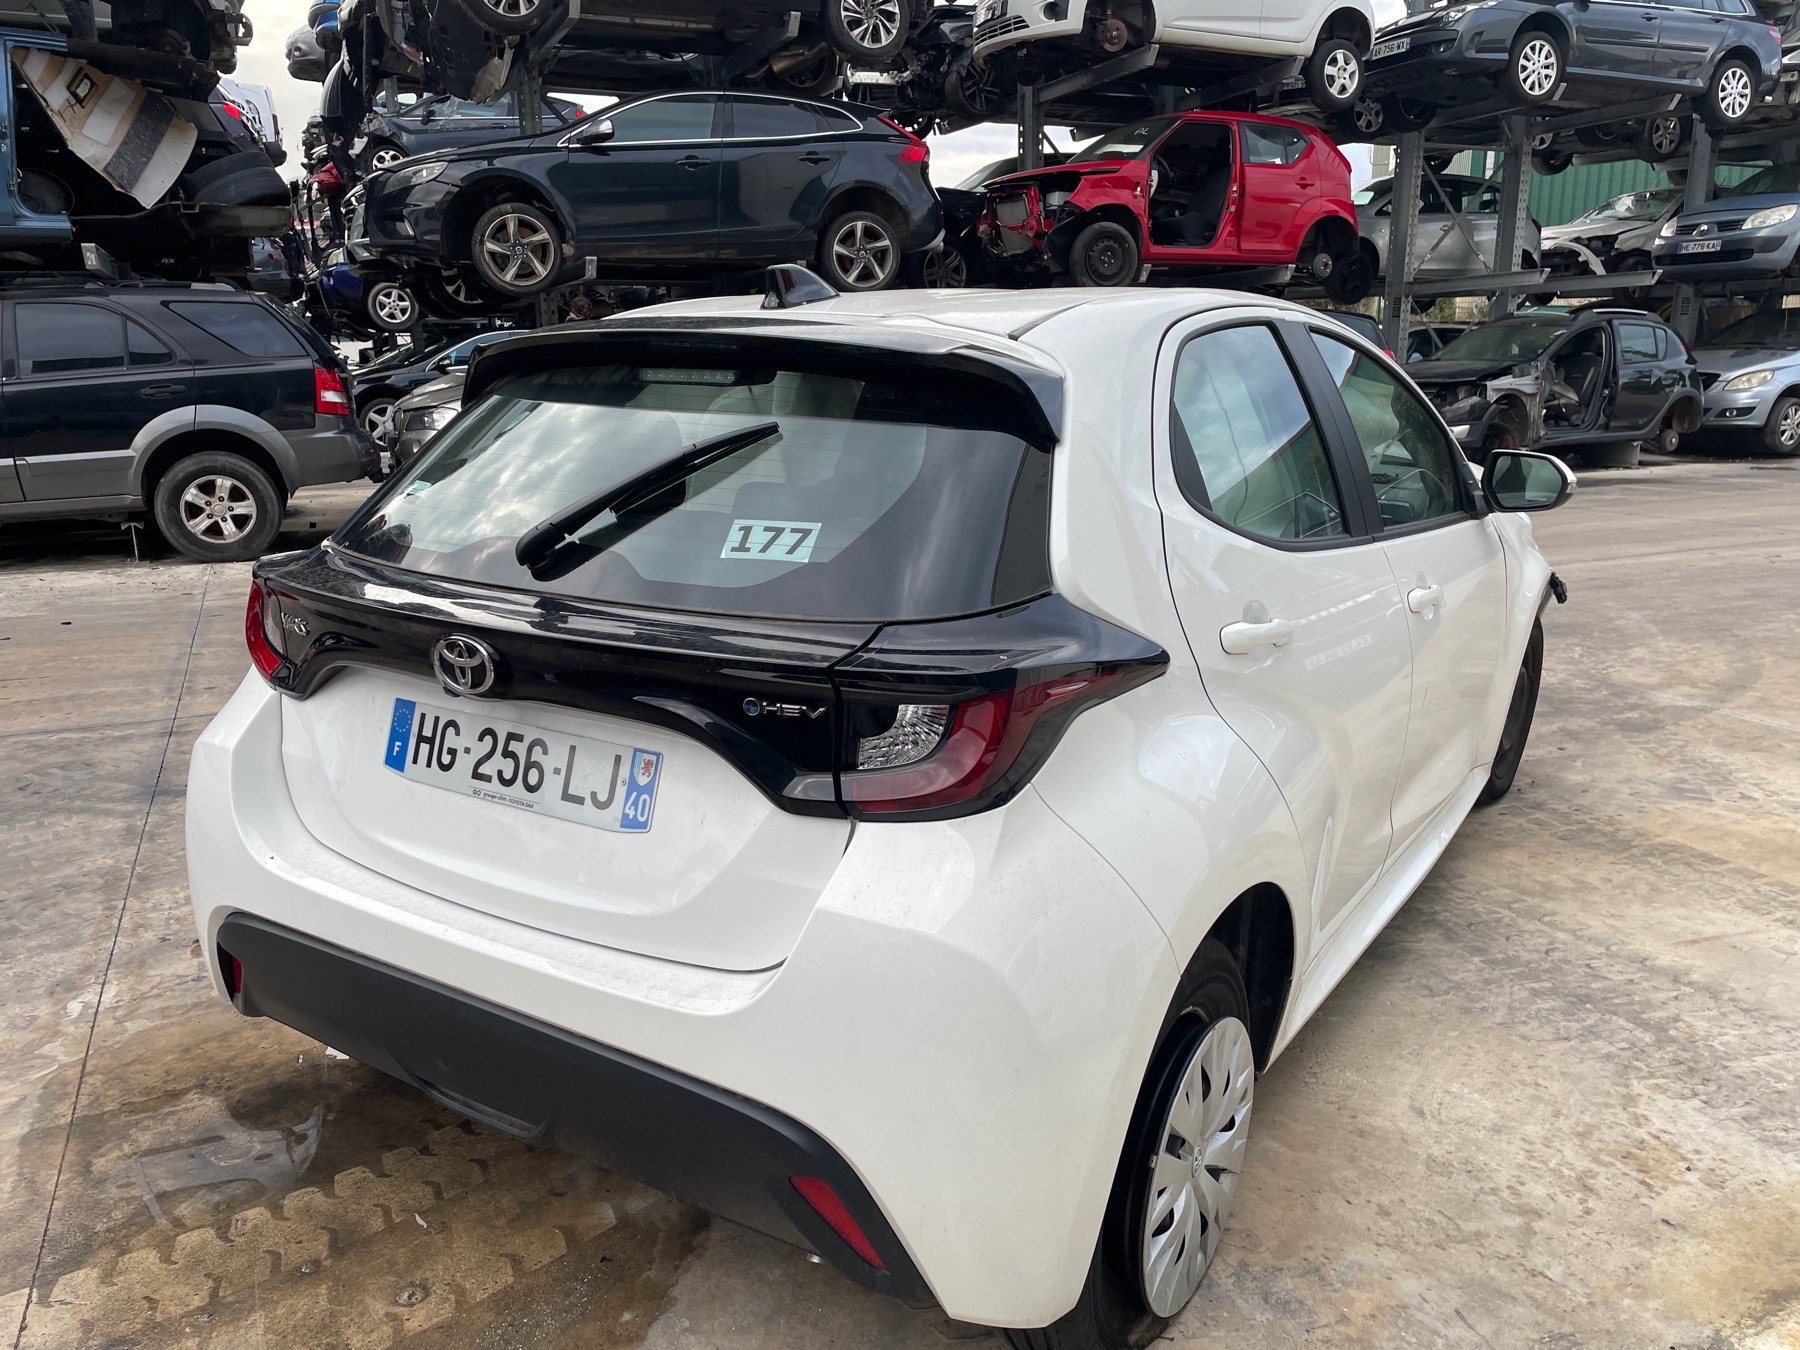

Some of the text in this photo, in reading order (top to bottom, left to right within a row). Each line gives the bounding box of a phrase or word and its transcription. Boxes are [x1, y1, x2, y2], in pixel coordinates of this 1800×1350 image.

[730, 525, 813, 555] 177
[762, 701, 827, 719] HEV
[392, 741, 402, 756] F
[412, 712, 622, 810] HG-256-LJ
[623, 791, 651, 823] 40
